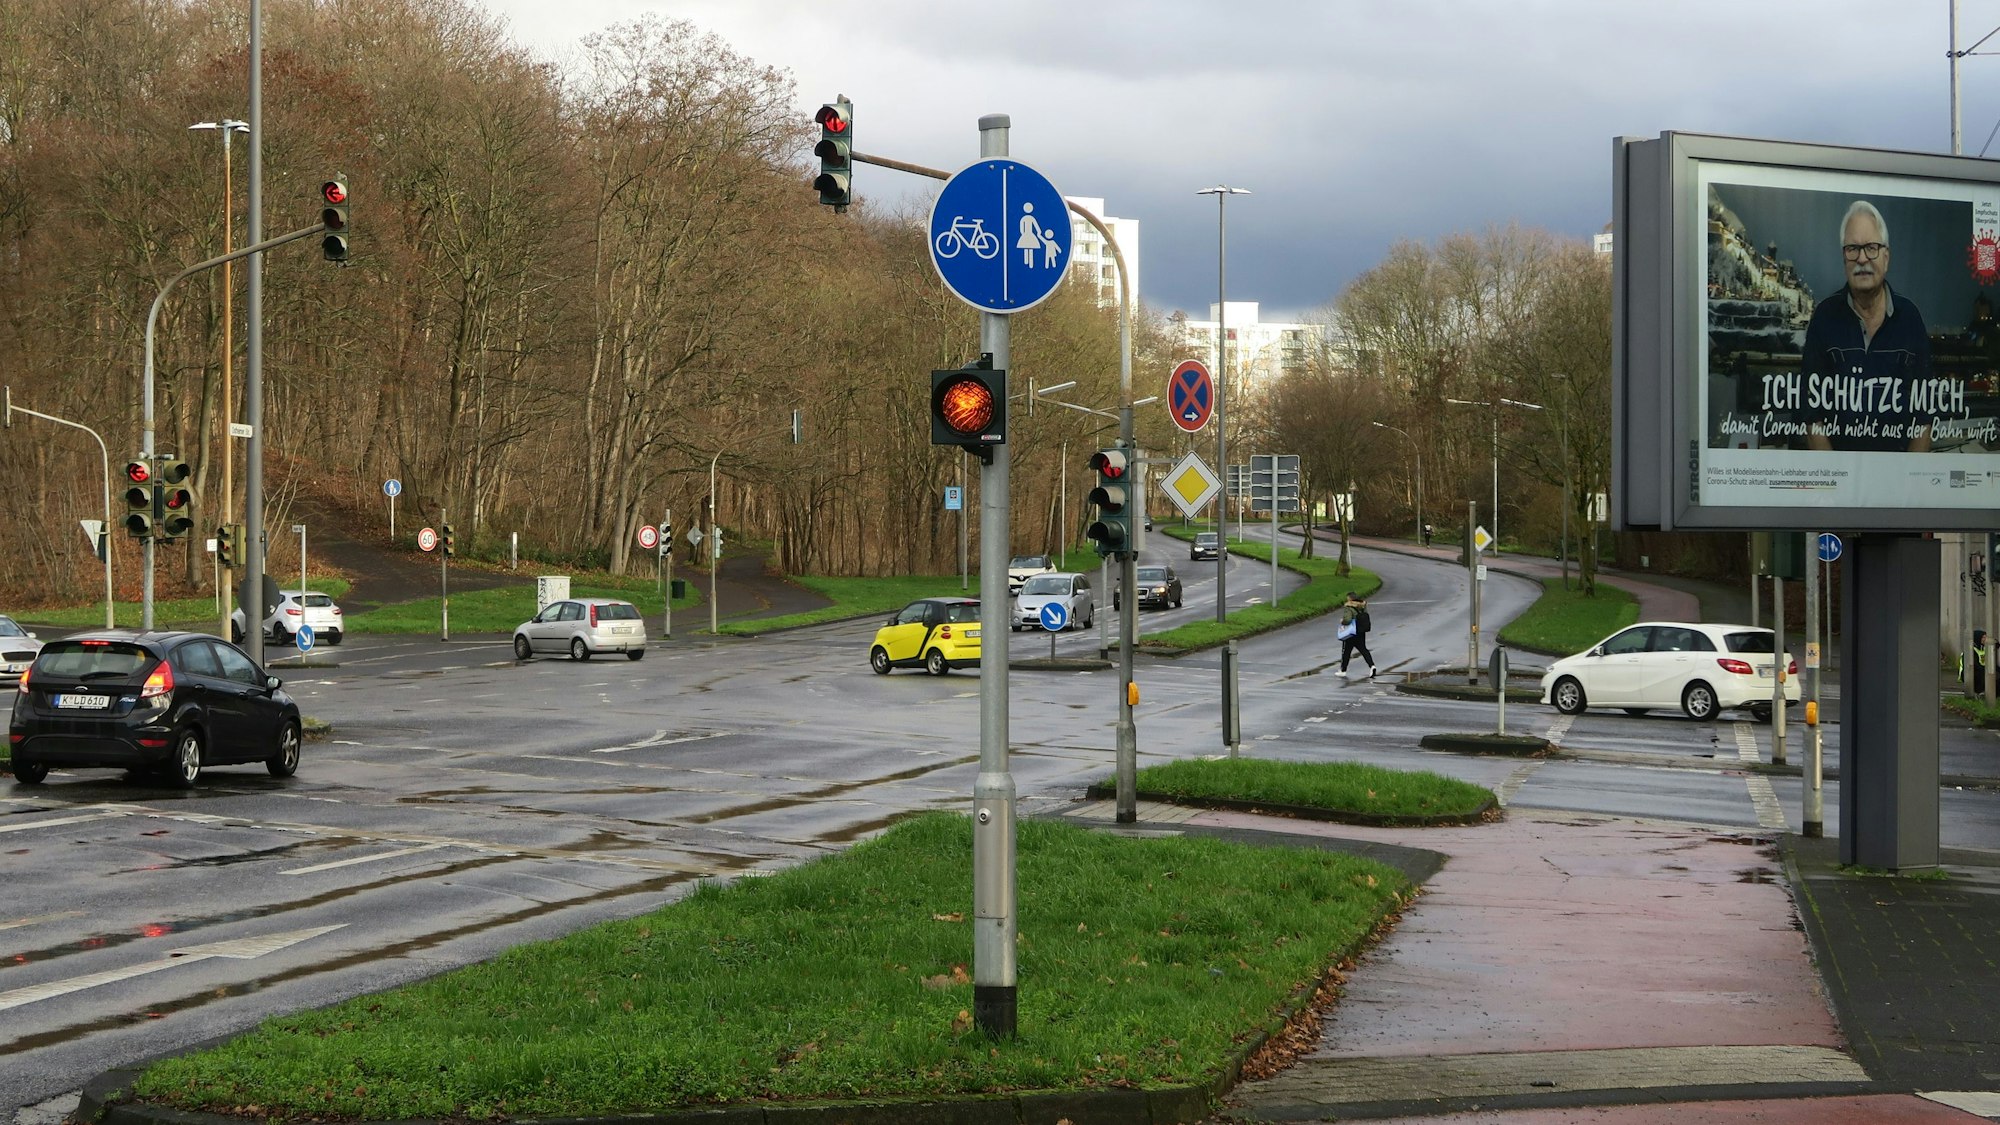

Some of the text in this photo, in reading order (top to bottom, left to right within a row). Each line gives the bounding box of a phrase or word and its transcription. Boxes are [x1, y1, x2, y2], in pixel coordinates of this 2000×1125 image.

[1762, 366, 1970, 420] ICH SCHÜTZE MICH,
[1721, 410, 1998, 444] damit Corona mich nicht aus der Bahn wirft
[1689, 440, 1699, 502] STRÖER
[1707, 467, 1725, 475] Willes
[1733, 468, 1808, 477] Modelleisenbahn-Liebhaber
[1820, 468, 1831, 477] hält
[1831, 469, 1849, 477] seinen
[1707, 477, 1748, 486] Corona-Schutz
[1769, 478, 1837, 487] zusammengegencorona.de
[423, 535, 433, 544] 60
[88, 696, 105, 706] 610
